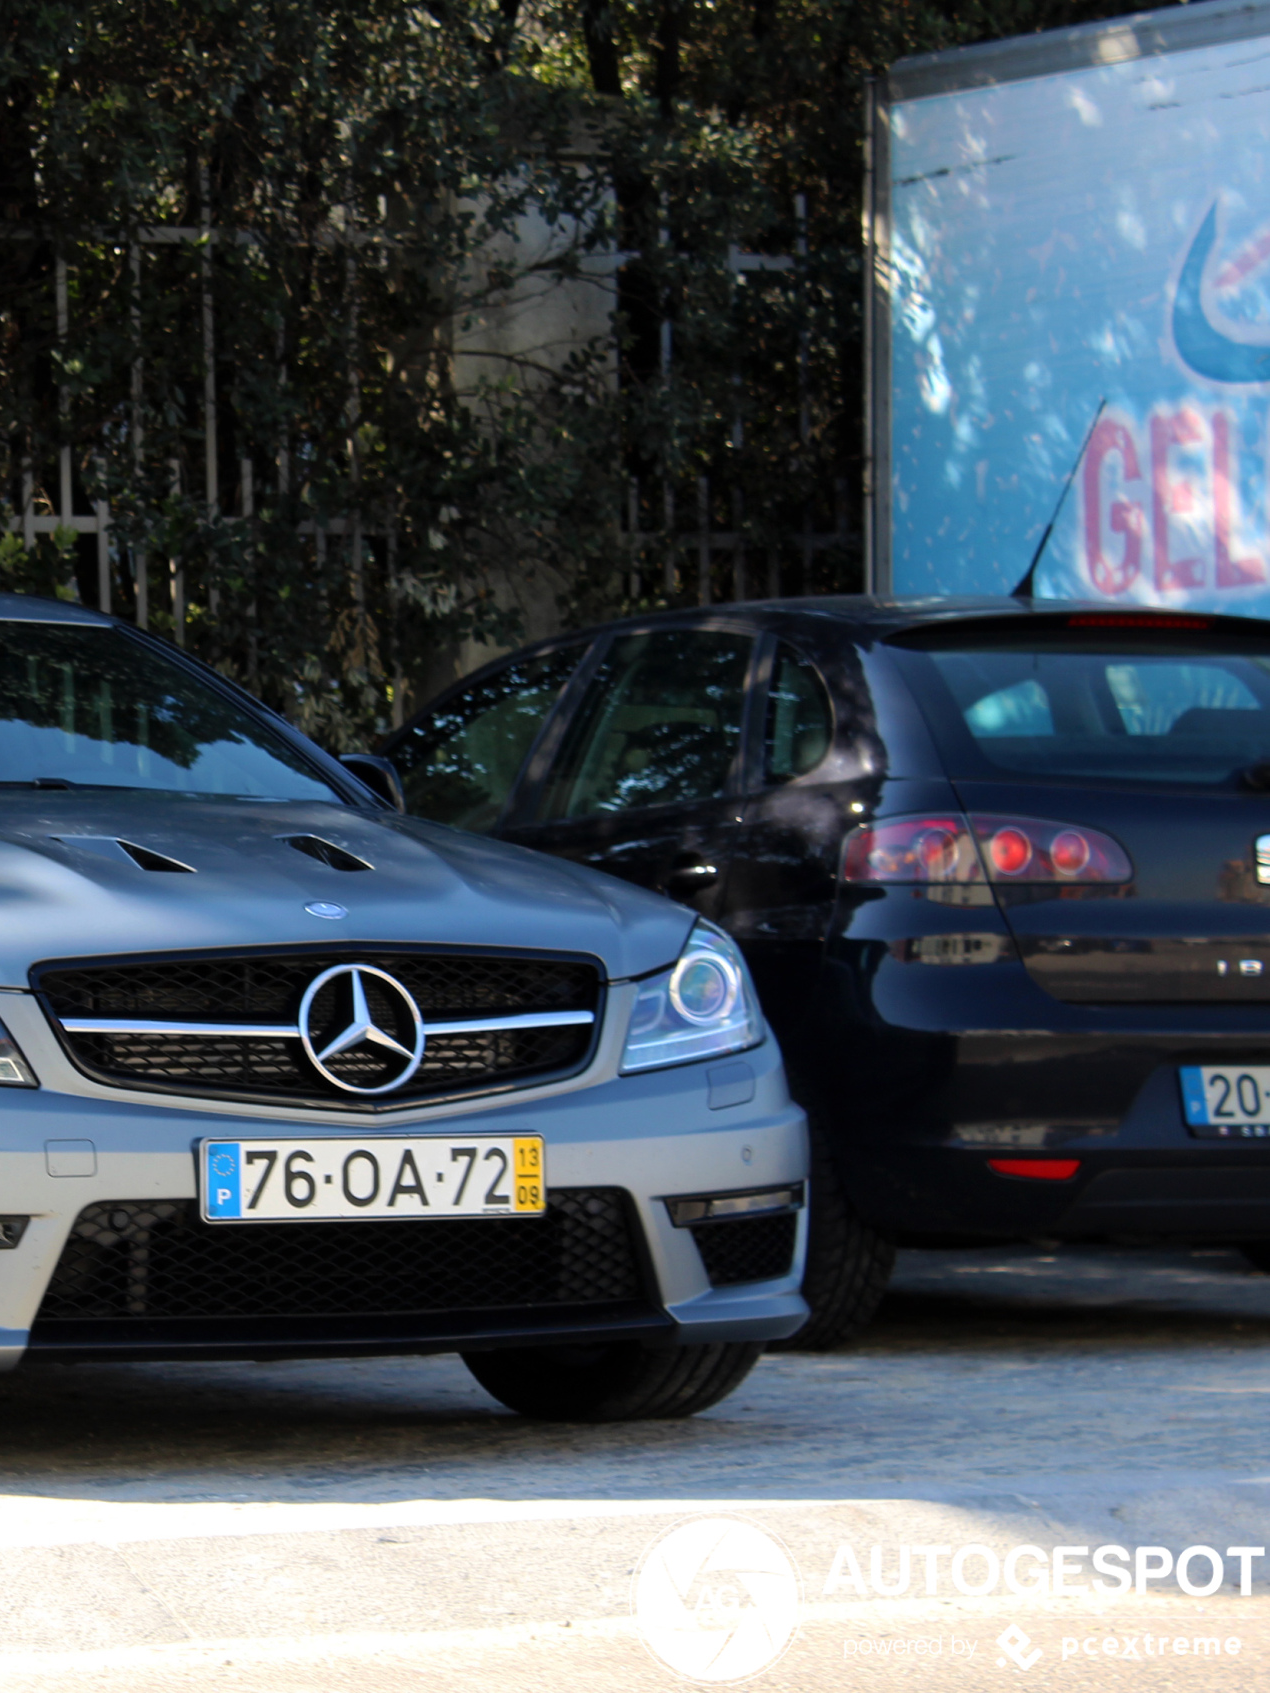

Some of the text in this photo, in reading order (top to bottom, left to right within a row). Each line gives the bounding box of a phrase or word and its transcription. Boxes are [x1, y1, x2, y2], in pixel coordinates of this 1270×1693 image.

[518, 1147, 539, 1167] 13
[217, 1188, 232, 1205] P
[517, 1185, 539, 1205] 09
